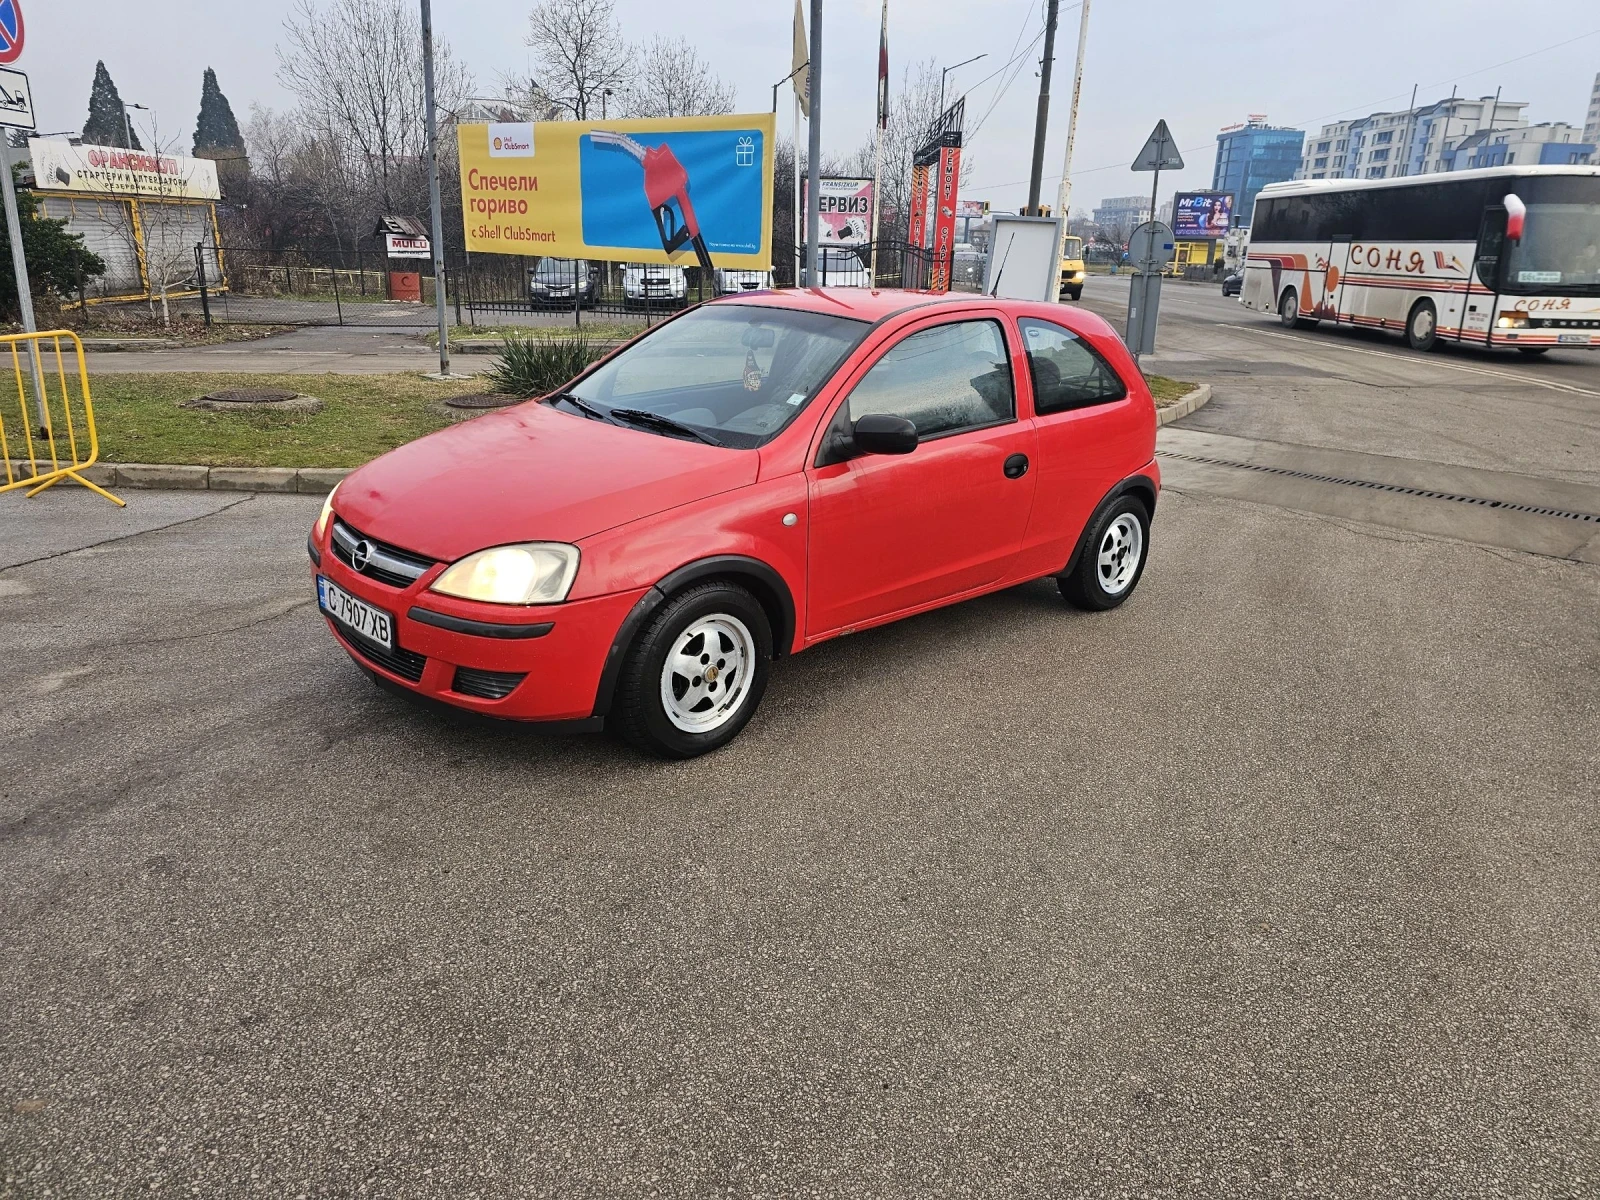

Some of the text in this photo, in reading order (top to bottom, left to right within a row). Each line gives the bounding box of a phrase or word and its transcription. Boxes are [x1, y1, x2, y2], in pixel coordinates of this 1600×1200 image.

[88, 149, 179, 176] ФРАНСИЗКУП
[77, 169, 123, 182] СТАРТЕРИ
[468, 168, 538, 191] Спечели
[944, 148, 954, 201] РЕМОНТ
[470, 198, 528, 220] гориво
[818, 195, 868, 213] ЕРВИЗ
[1178, 196, 1212, 208] MrBit
[478, 224, 501, 239] Shell
[503, 225, 556, 242] ClubSmart
[1351, 244, 1426, 275] СОНЯ
[1514, 298, 1572, 312] СОНЯ
[340, 593, 368, 631] 7907
[370, 611, 389, 642] XB
